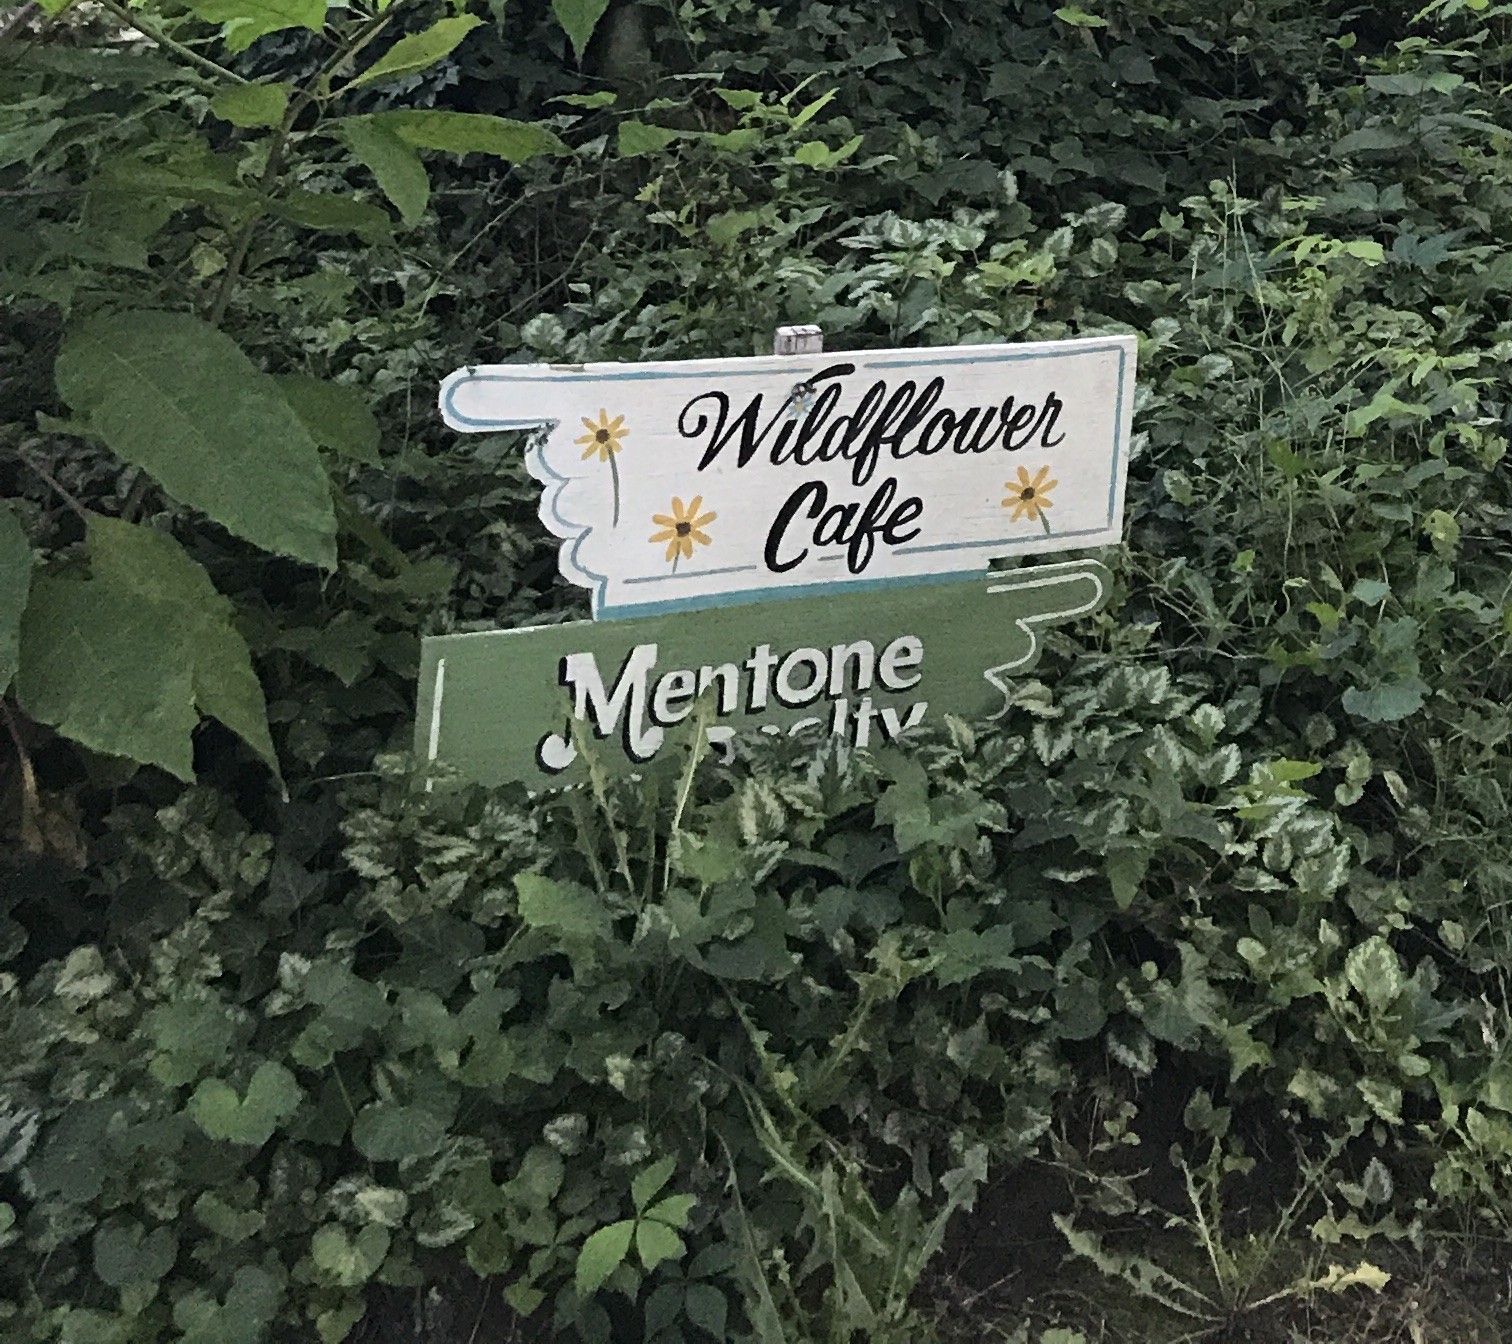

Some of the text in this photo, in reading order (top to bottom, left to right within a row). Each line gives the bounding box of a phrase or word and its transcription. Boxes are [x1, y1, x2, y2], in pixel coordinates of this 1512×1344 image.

[678, 363, 1066, 486] Wildflower
[764, 477, 924, 574] Cafe
[536, 634, 924, 771] Mentone
